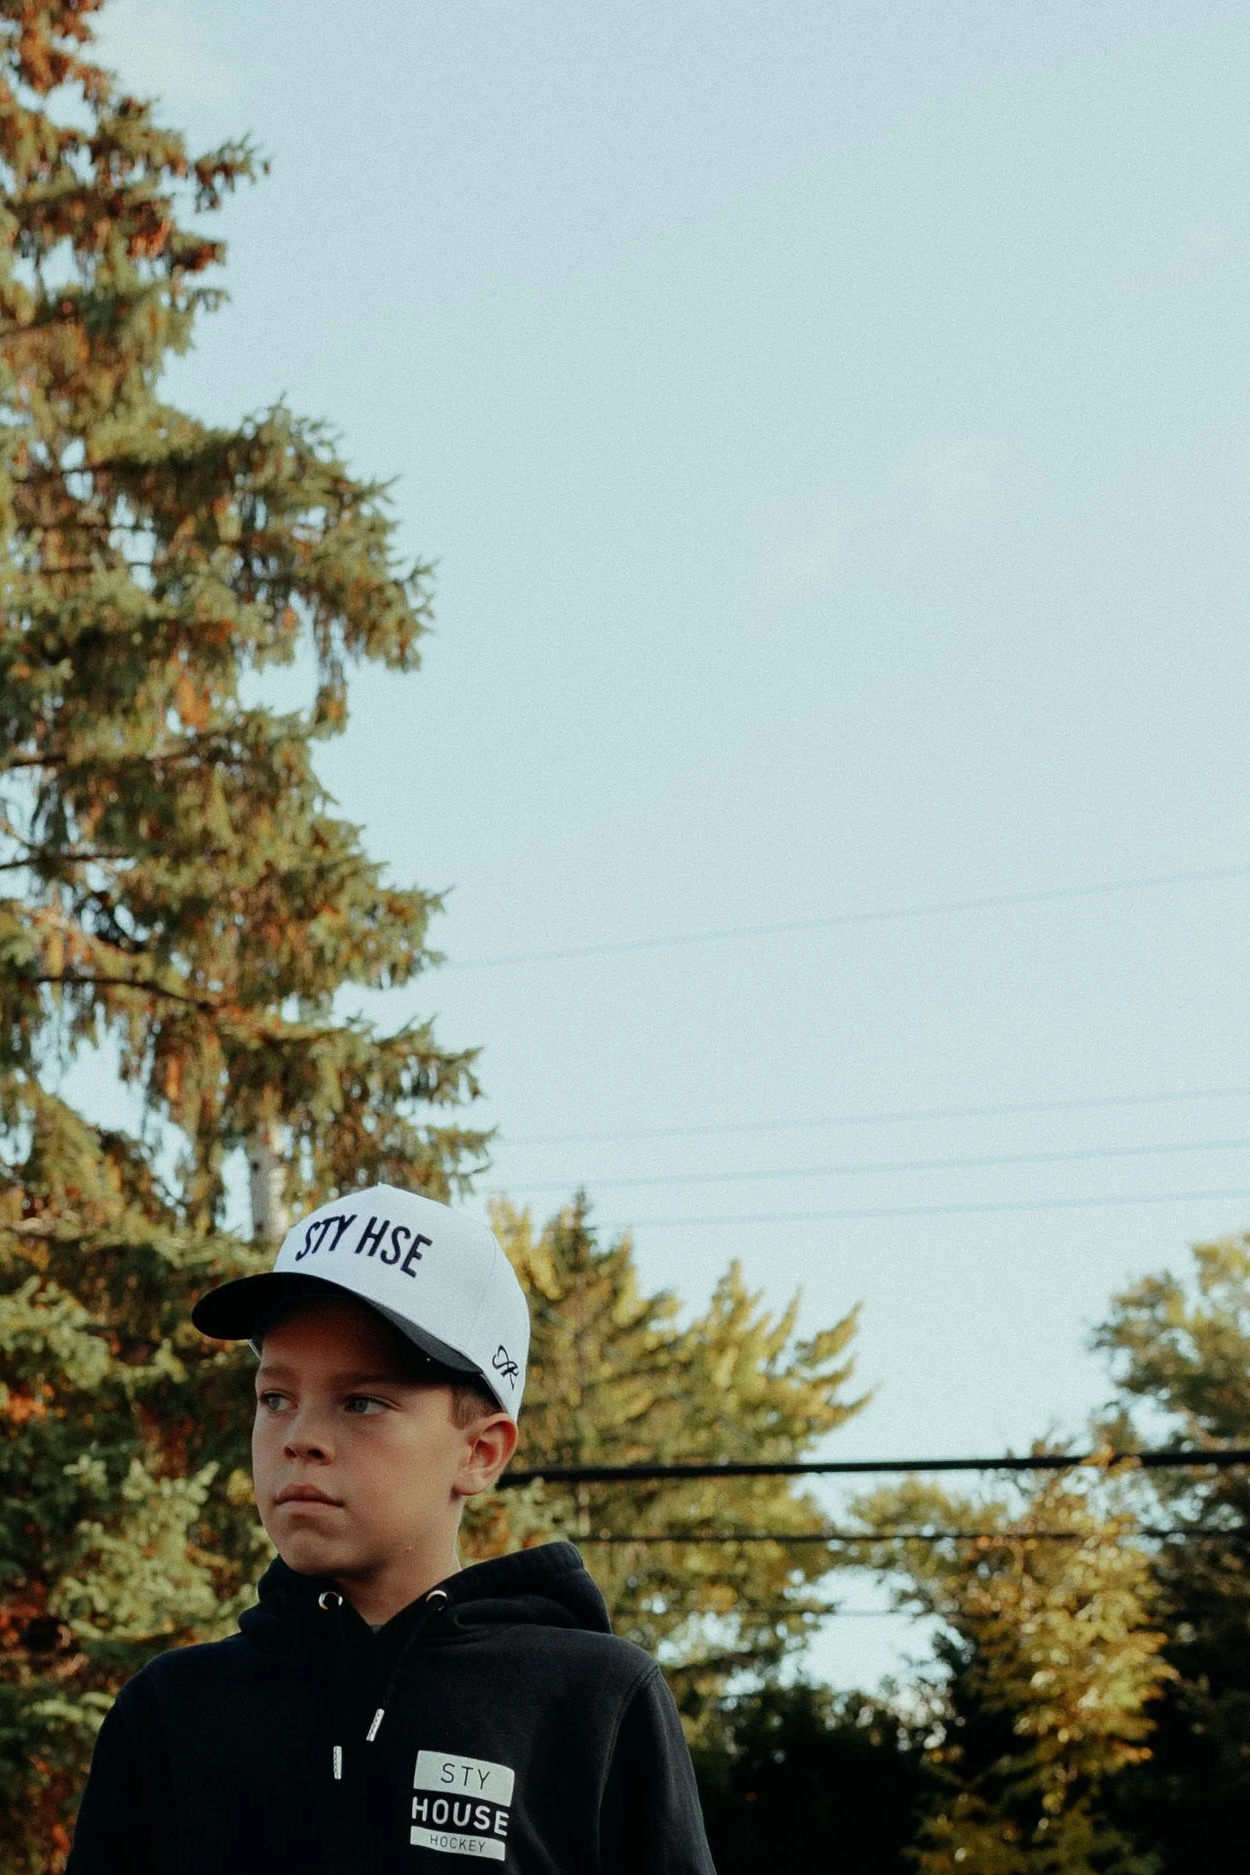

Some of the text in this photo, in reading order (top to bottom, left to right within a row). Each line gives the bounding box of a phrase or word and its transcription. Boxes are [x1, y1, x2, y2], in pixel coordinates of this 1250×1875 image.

[295, 1214, 433, 1278] STY HSE
[440, 1763, 490, 1790] STY
[411, 1796, 510, 1837] HOUSE
[429, 1834, 487, 1853] HOCKEY
